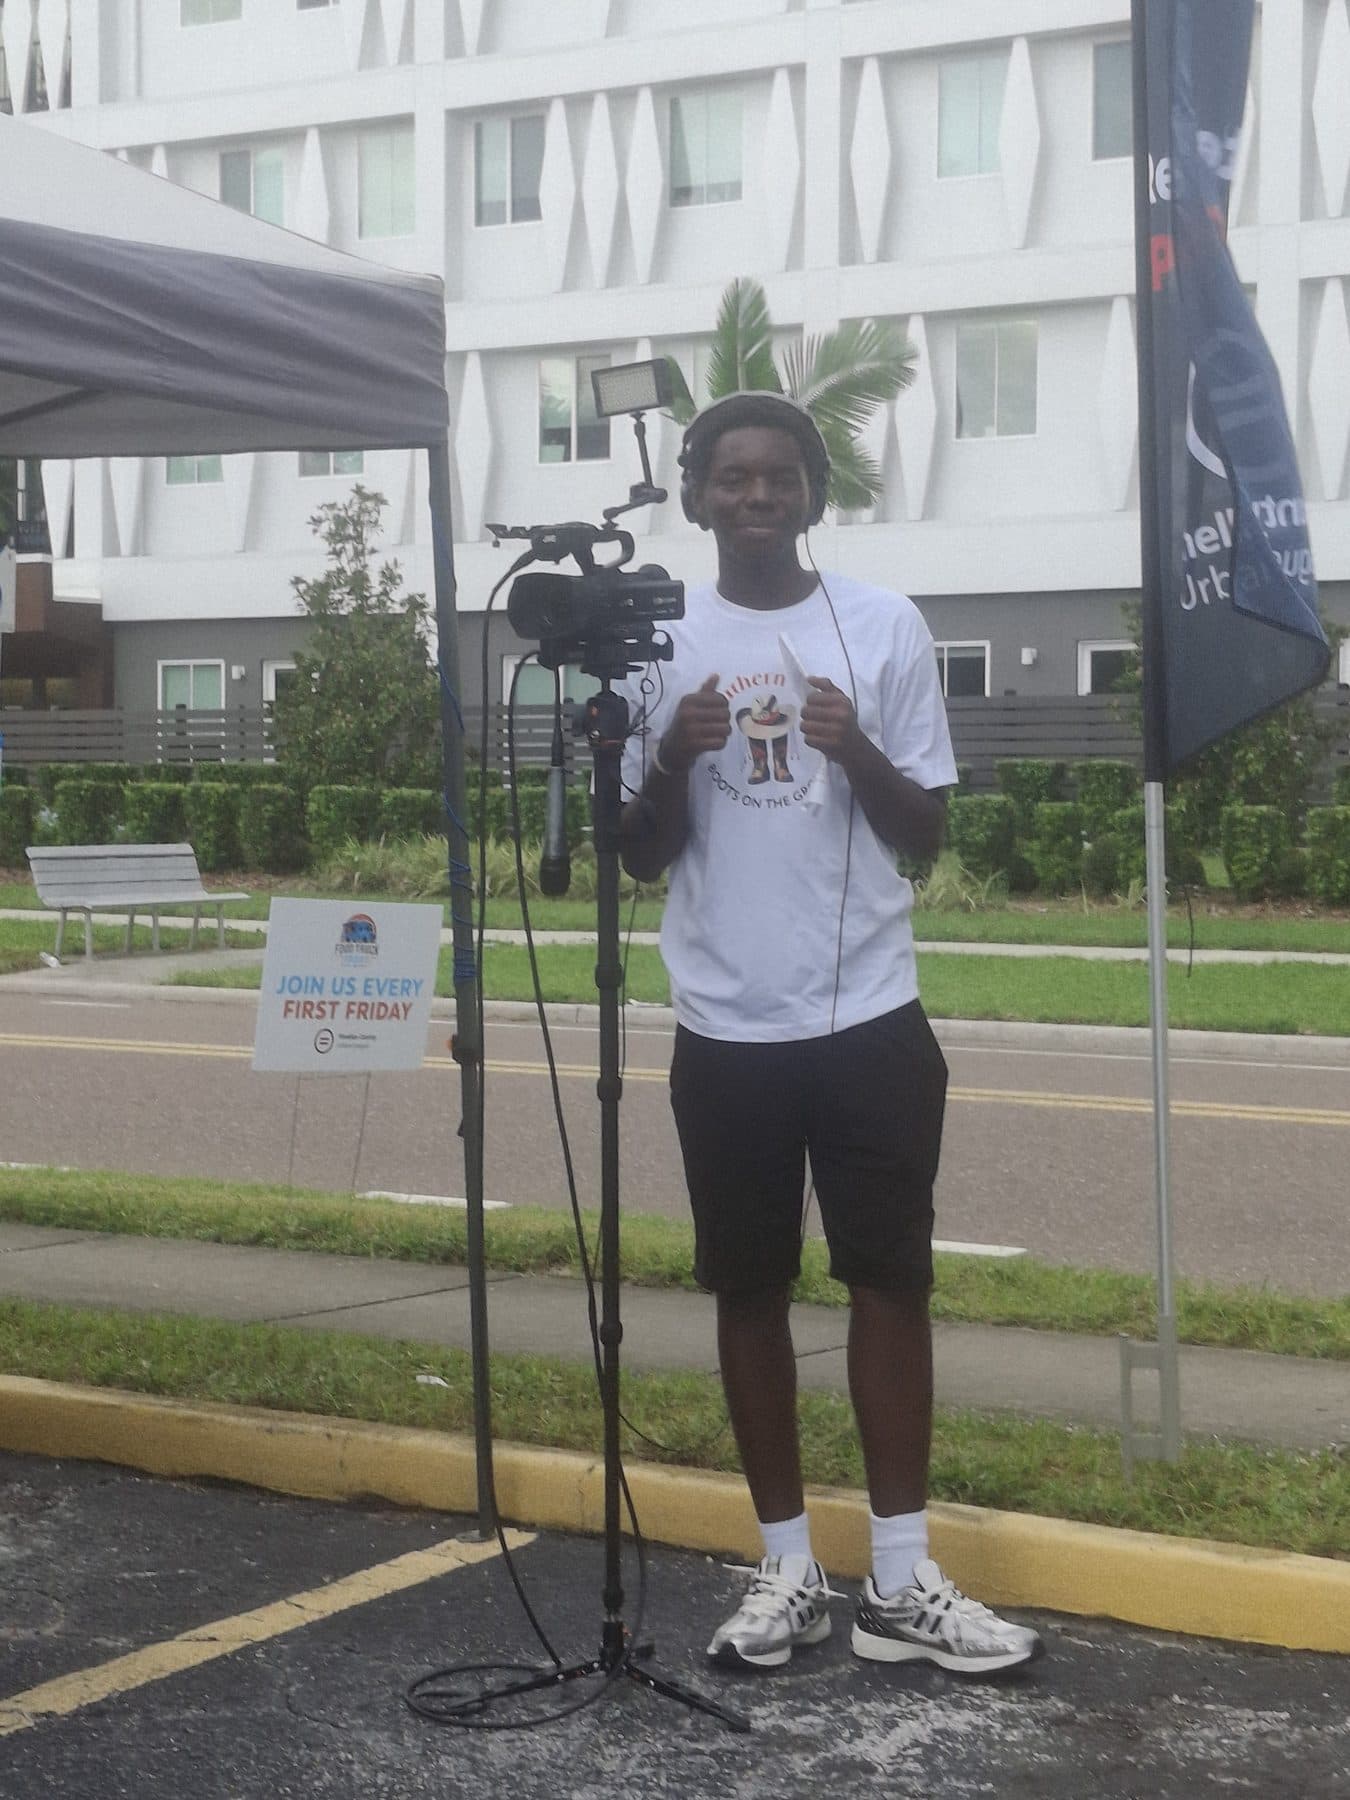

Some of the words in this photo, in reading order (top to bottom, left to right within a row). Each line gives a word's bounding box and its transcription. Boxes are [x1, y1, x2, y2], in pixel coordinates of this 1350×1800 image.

[707, 763, 741, 801] BOOTS
[741, 795, 762, 809] ON
[766, 795, 793, 809] THE
[276, 975, 325, 996] JOIN
[331, 977, 356, 996] US
[363, 978, 424, 997] EVERY
[283, 1000, 340, 1020] FIRST
[345, 1001, 413, 1022] FRIDAY
